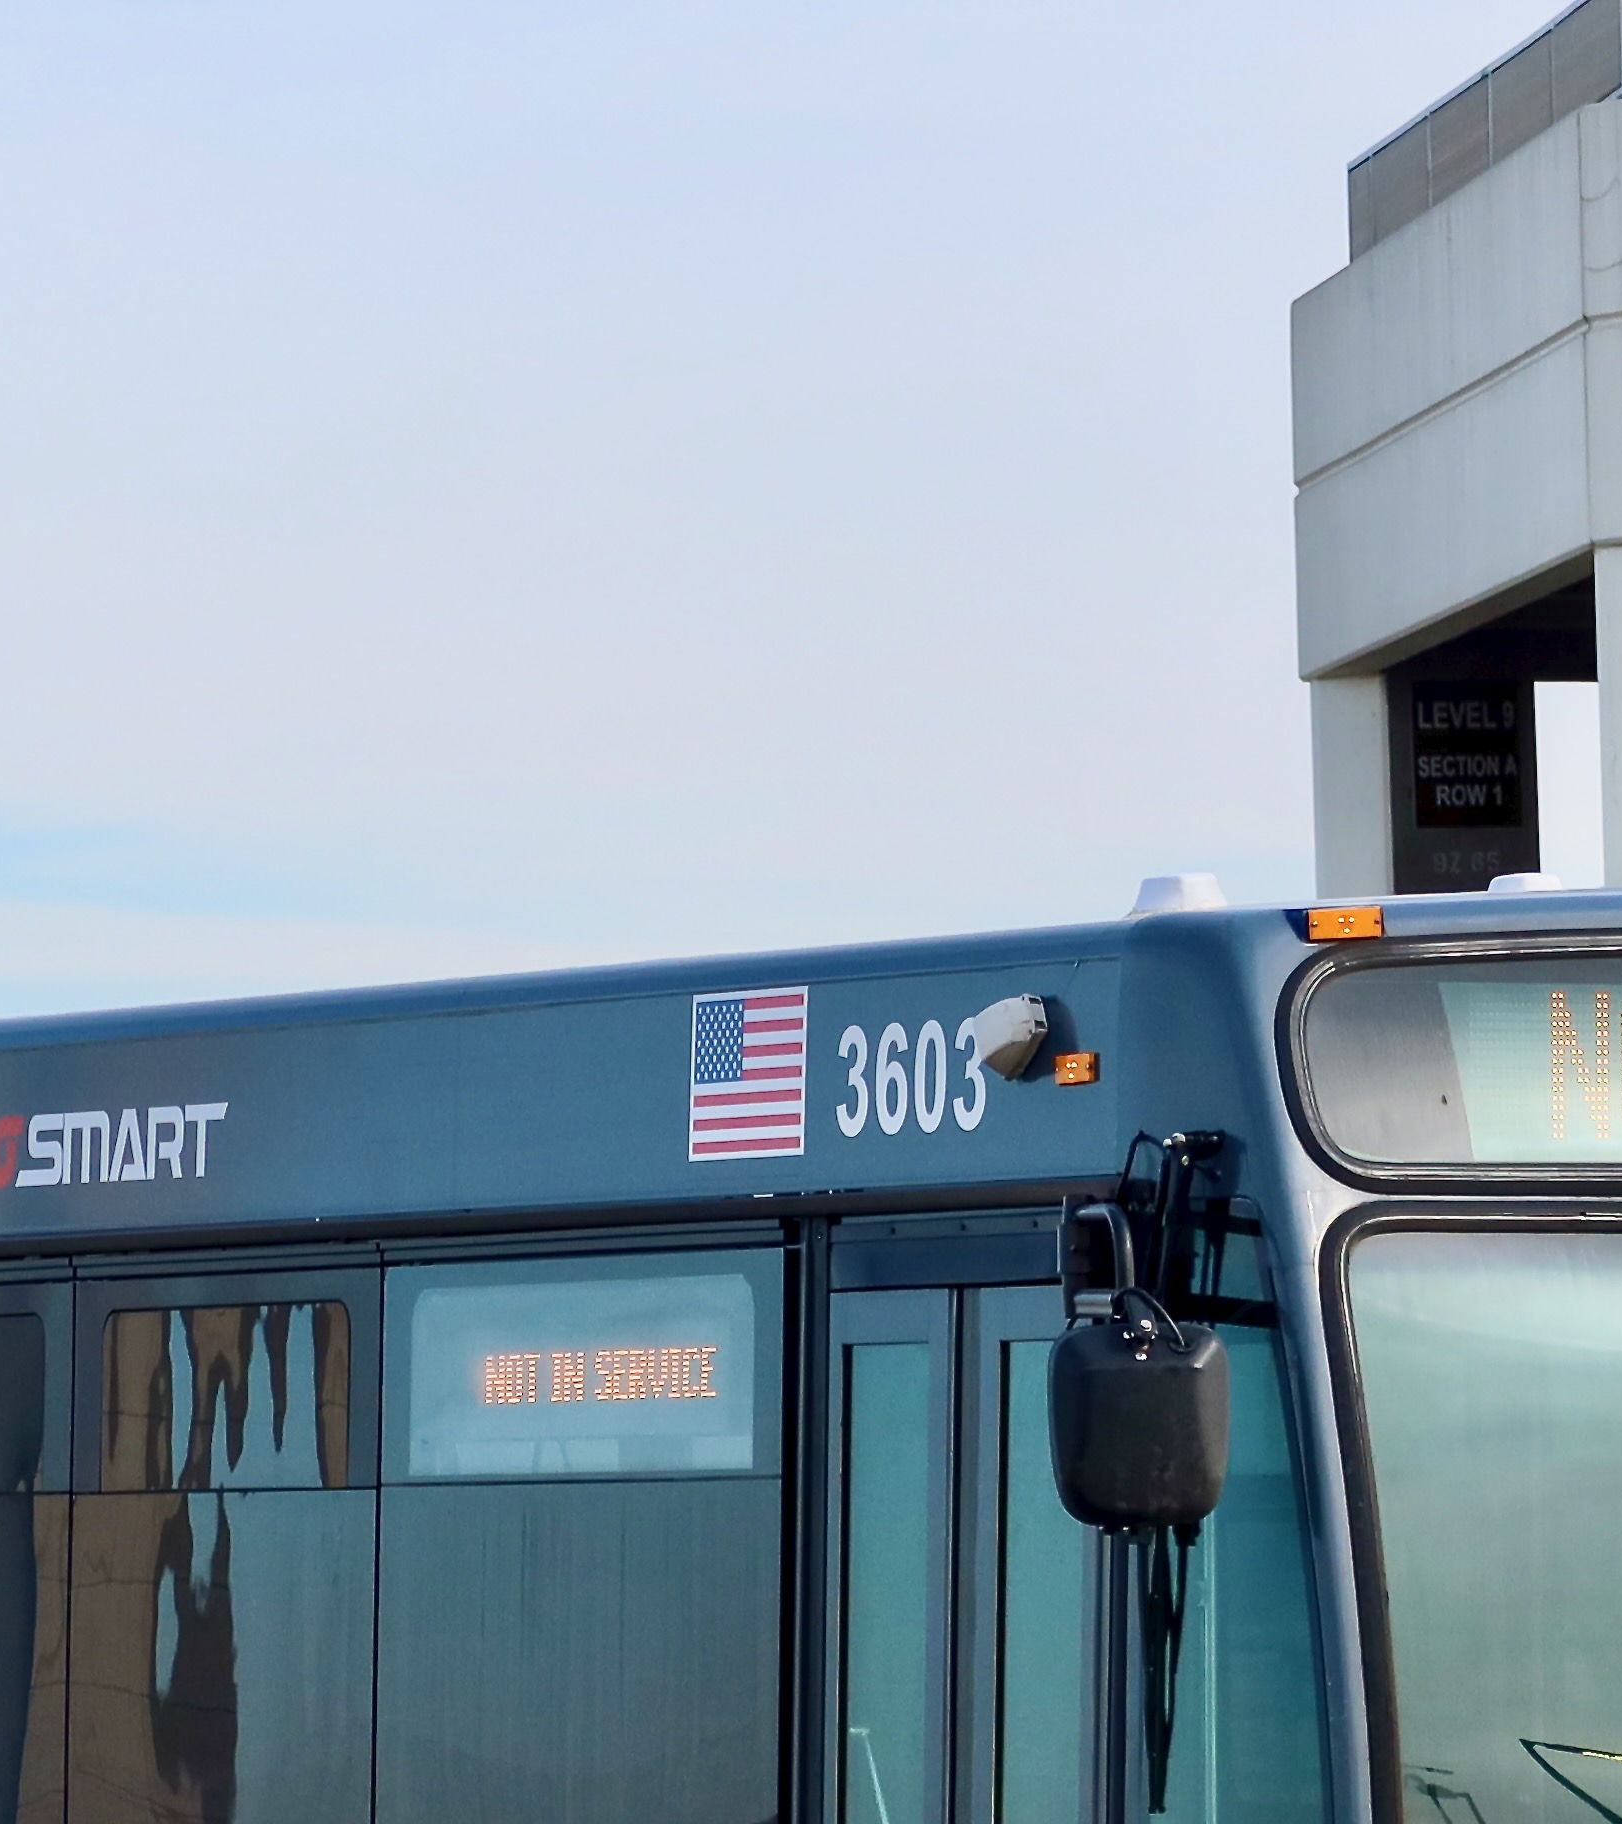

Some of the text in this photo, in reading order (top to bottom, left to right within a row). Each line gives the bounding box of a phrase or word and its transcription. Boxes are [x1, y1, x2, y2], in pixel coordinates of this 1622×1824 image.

[1417, 701, 1515, 730] LEVEL 9
[1417, 754, 1518, 779] SECTION A
[1435, 783, 1504, 808] ROW 1
[835, 1016, 987, 1138] 3603
[14, 1101, 229, 1188] SMART
[484, 1346, 719, 1404] NOT IN SERVICE
